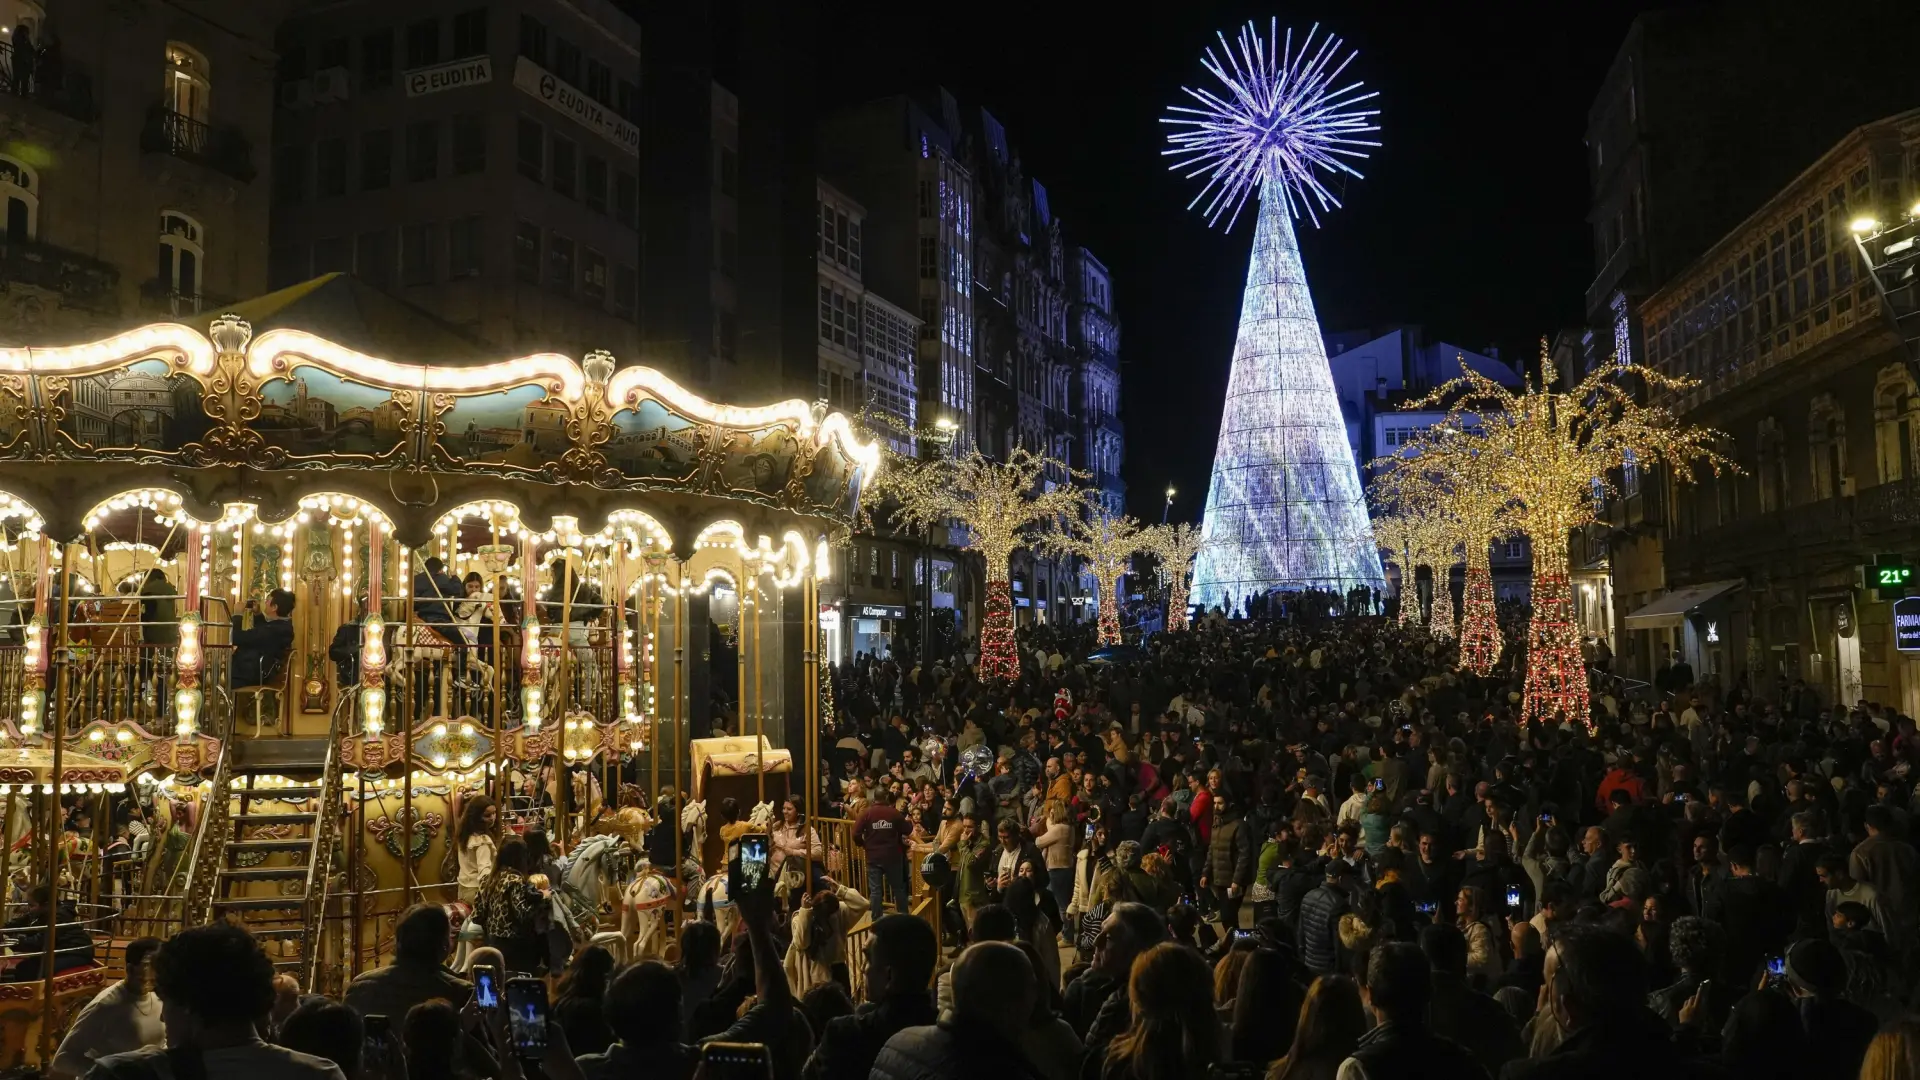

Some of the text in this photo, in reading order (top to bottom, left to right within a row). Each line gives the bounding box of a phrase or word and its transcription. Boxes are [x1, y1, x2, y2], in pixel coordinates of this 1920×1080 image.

[431, 64, 486, 88] EUDITA
[558, 88, 603, 126] EUDITA
[614, 122, 639, 147] AUD
[1880, 569, 1910, 584] 21°
[1896, 614, 1920, 627] FARMA
